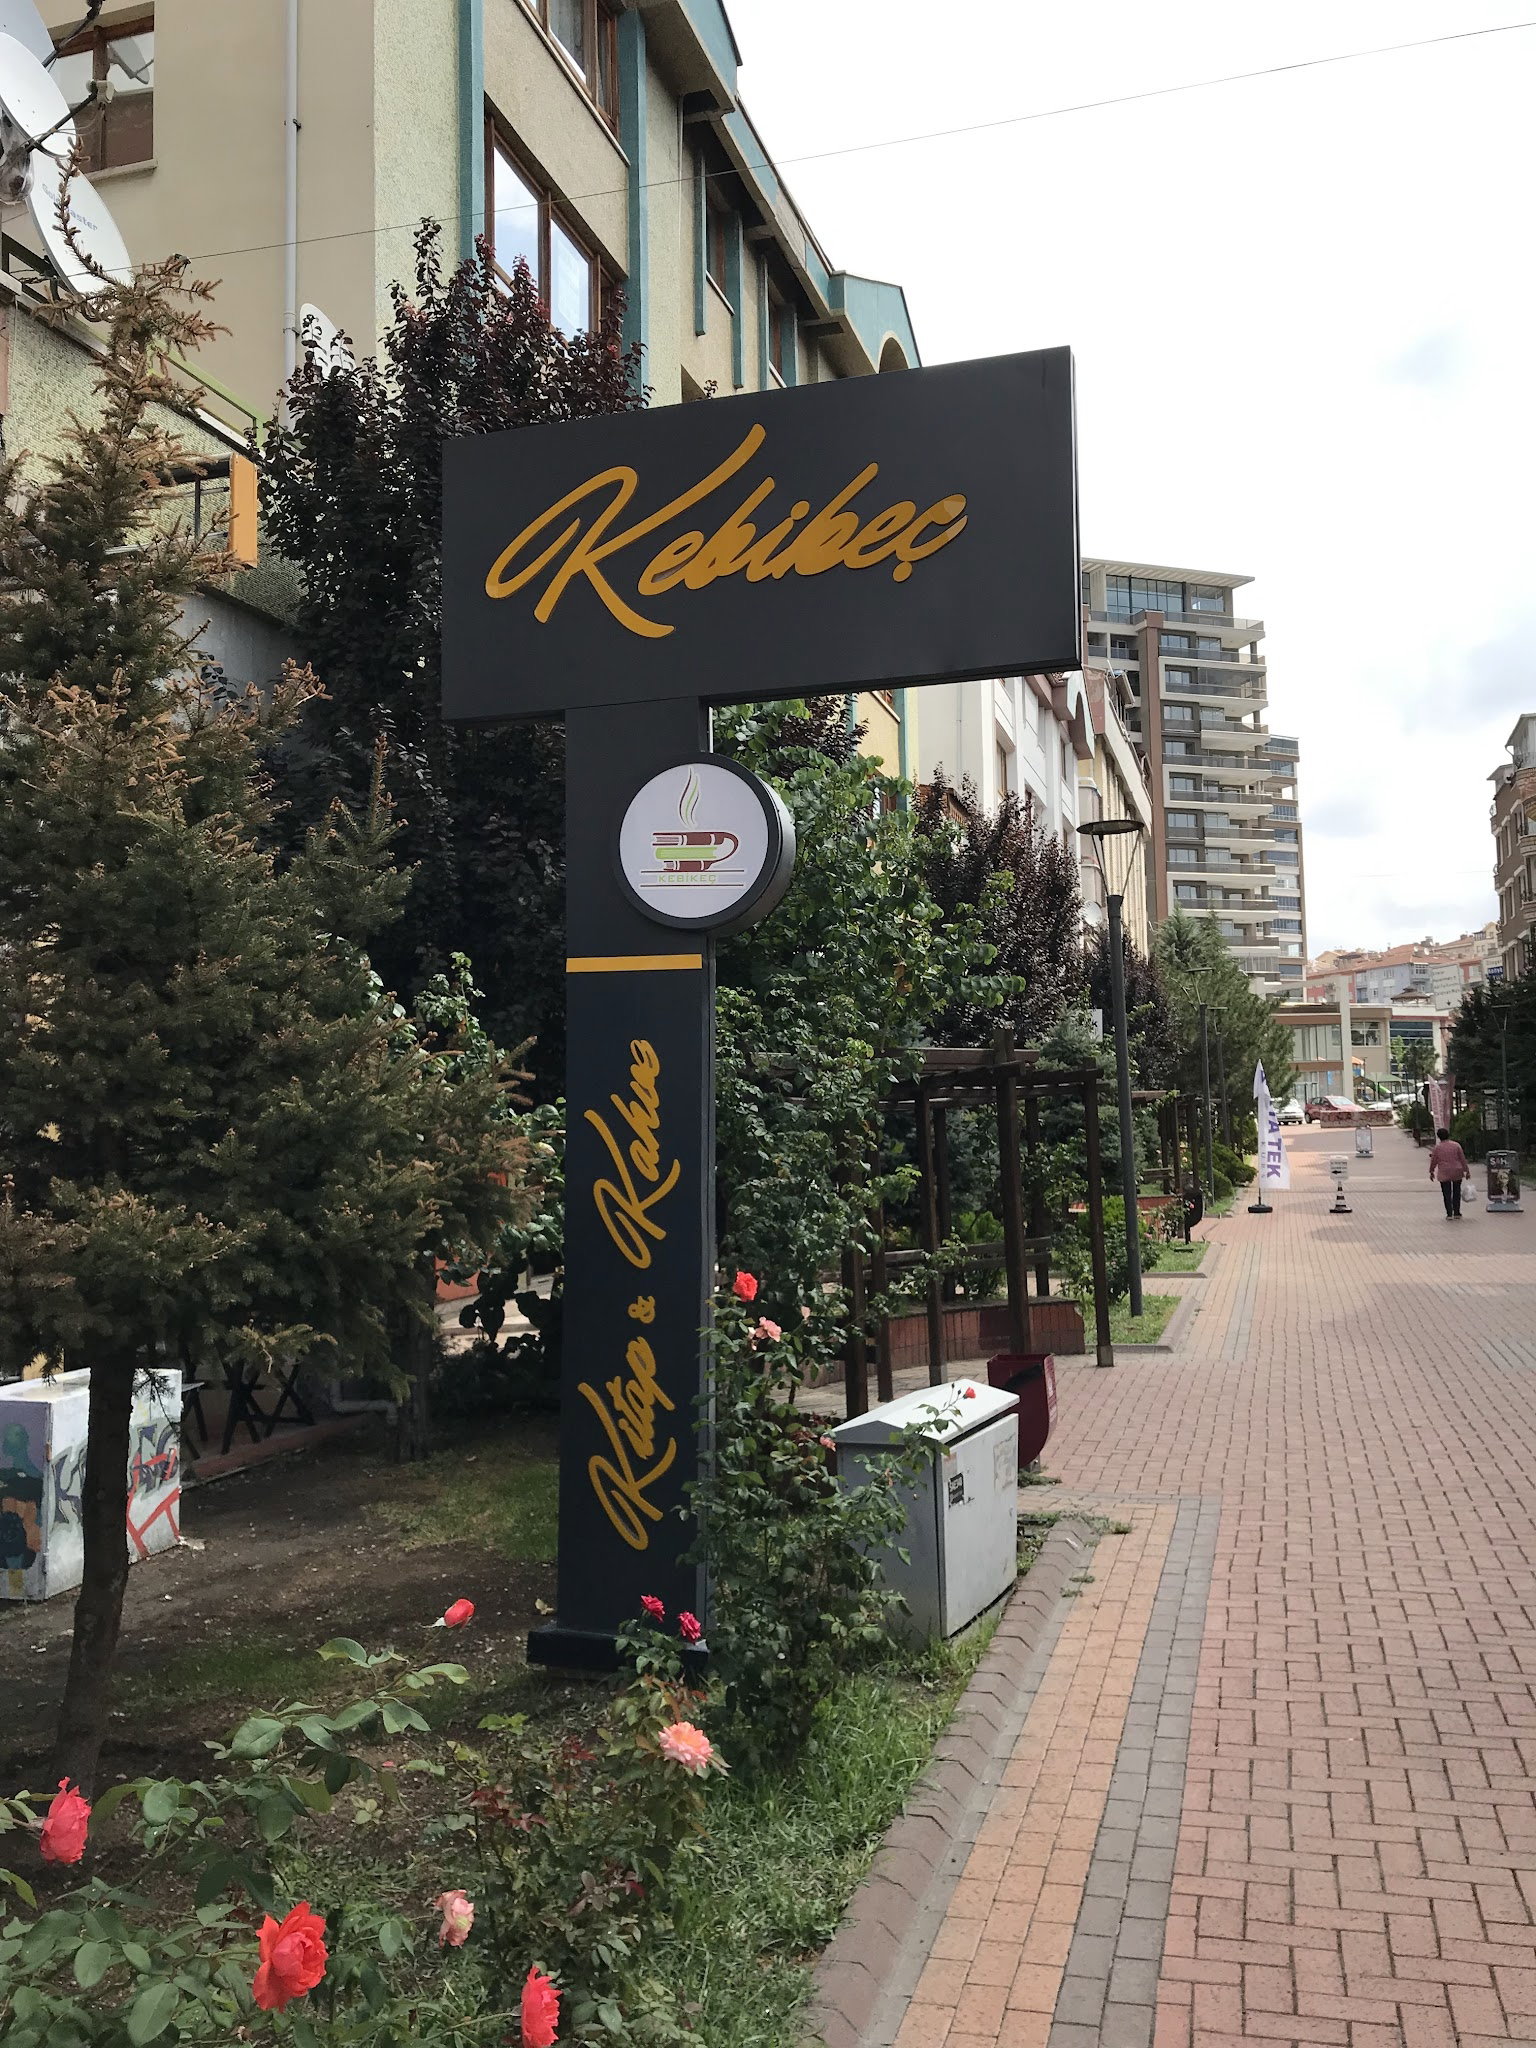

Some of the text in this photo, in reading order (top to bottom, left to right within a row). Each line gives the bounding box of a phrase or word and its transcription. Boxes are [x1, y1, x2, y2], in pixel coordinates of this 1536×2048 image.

[579, 1039, 681, 1550] Kitap & Kahve
